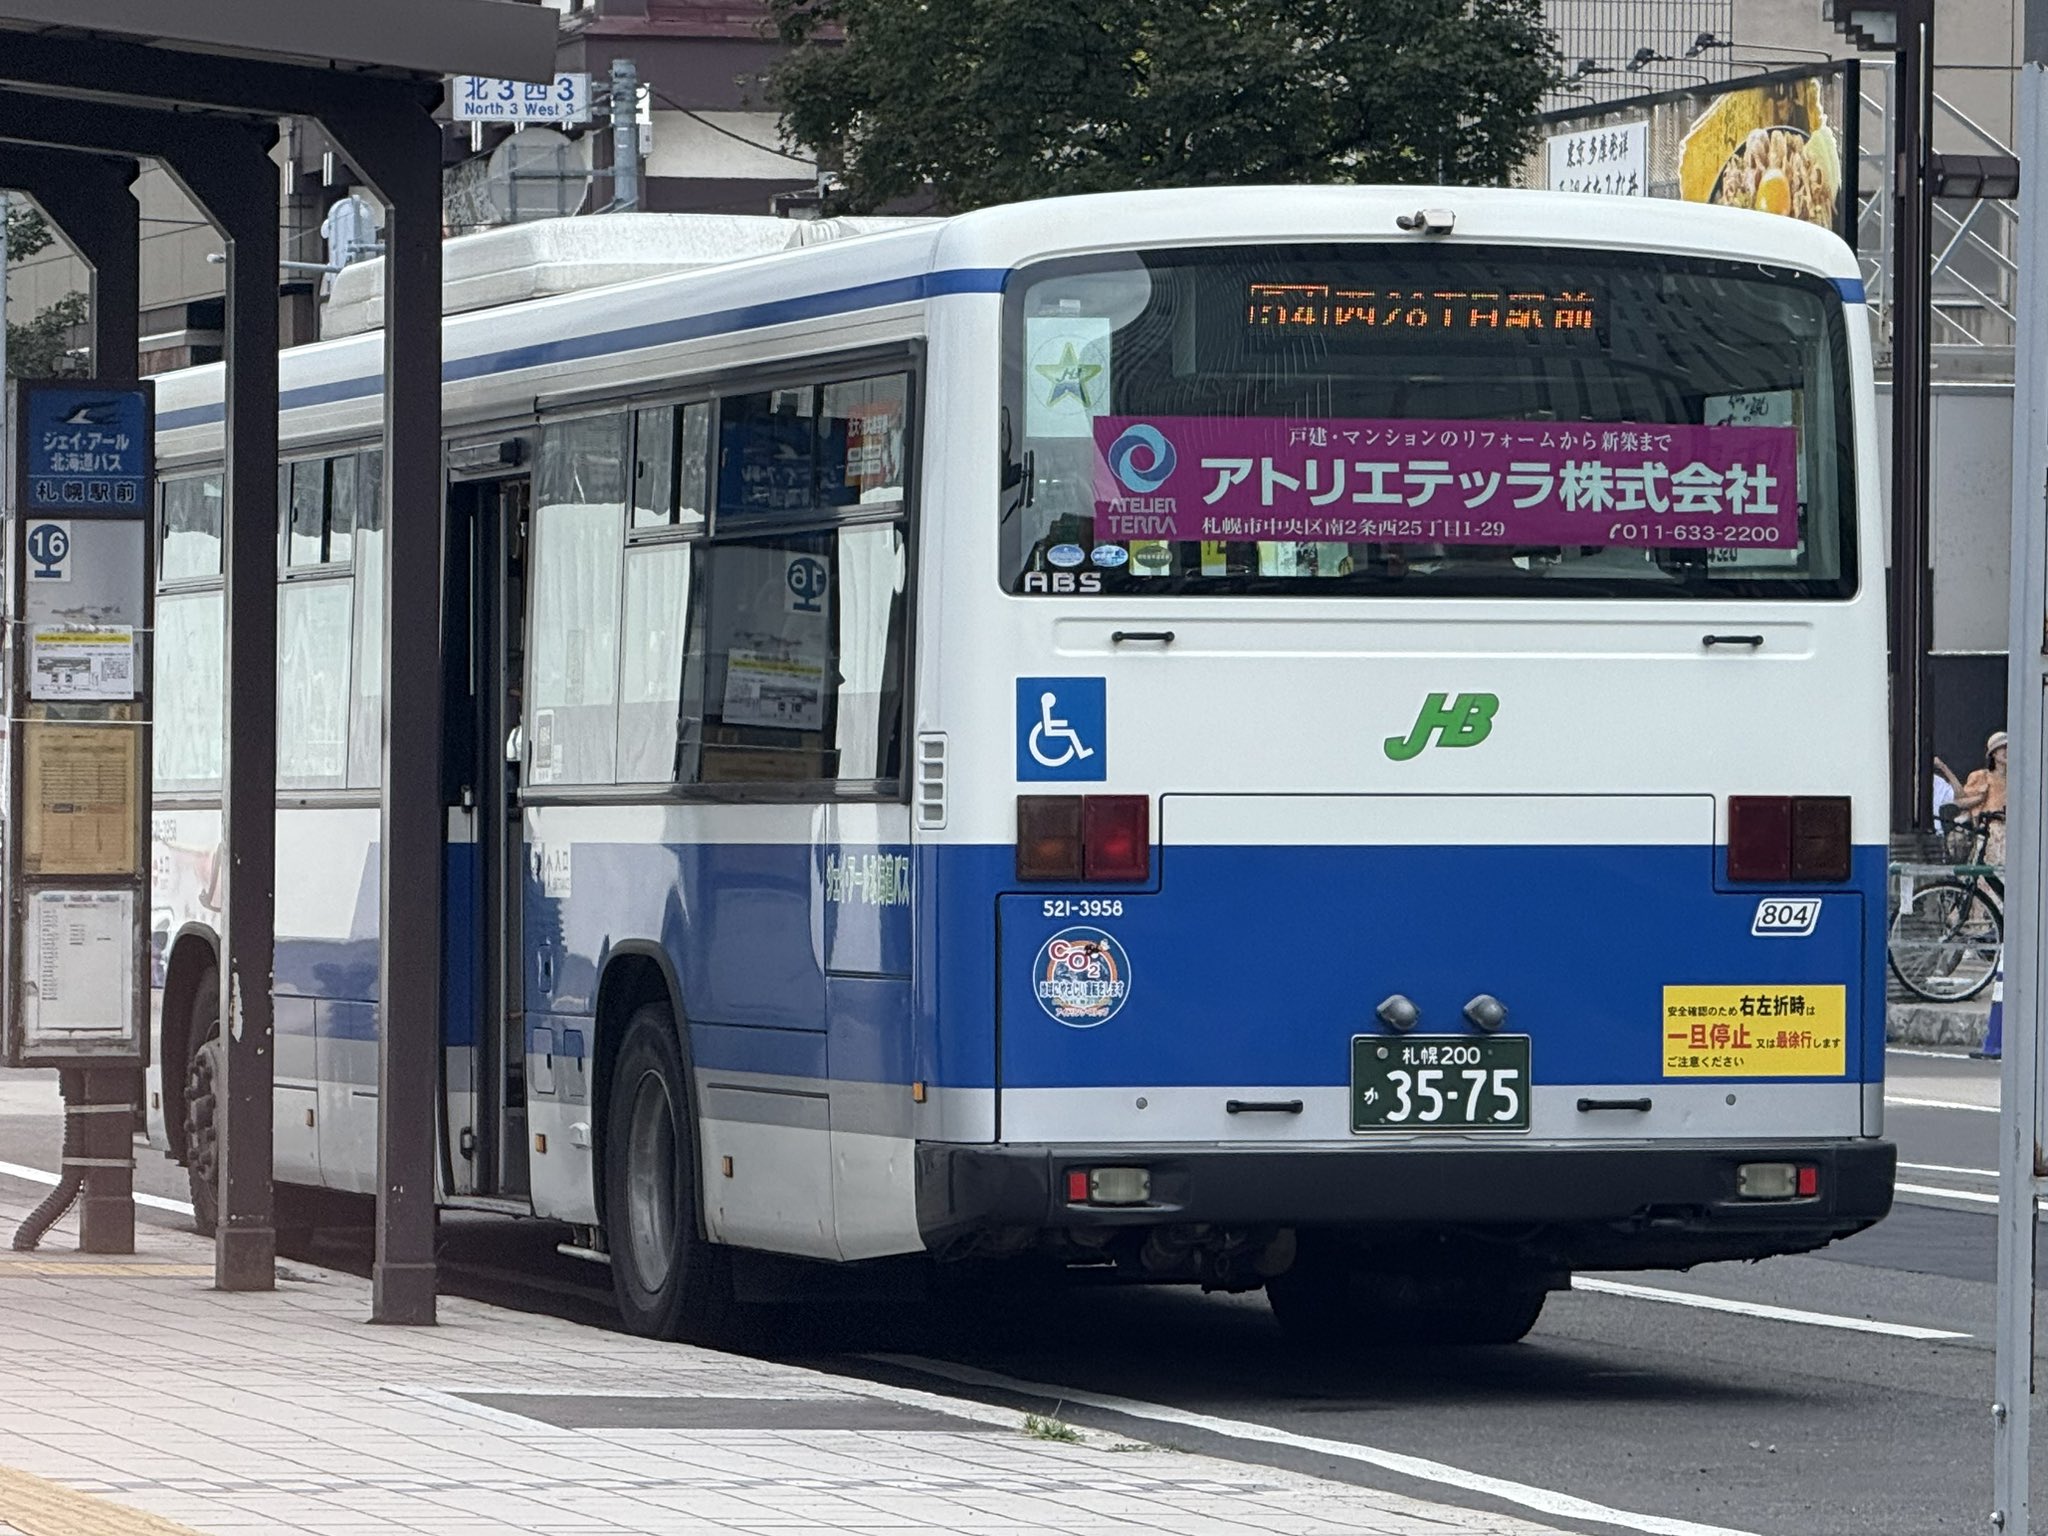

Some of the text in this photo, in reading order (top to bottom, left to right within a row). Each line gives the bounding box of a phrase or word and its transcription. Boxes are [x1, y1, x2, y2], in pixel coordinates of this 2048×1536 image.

[465, 102, 575, 116] North 3 West 3
[43, 431, 130, 450] ジェイ・アール
[1289, 426, 1673, 453] 戸建・マンションのリフォームから新築まで
[50, 453, 123, 473] 北海道バス
[36, 481, 138, 502] 札幌駅前
[1200, 456, 1779, 515] アトリエテッラ株式会社
[1108, 497, 1177, 514] ATELIER
[1108, 515, 1177, 535] TERRA
[1201, 517, 1506, 539] 札幌市中央区南2条西25丁目1-29
[1623, 525, 1780, 543] 011-633-2200
[33, 531, 67, 556] 16
[1024, 571, 1102, 593] ABS
[1042, 899, 1124, 917] 521-3958
[1761, 904, 1808, 925] 804
[1667, 1056, 1745, 1068] ご注意ください
[1364, 1068, 1520, 1122] か 35-75
